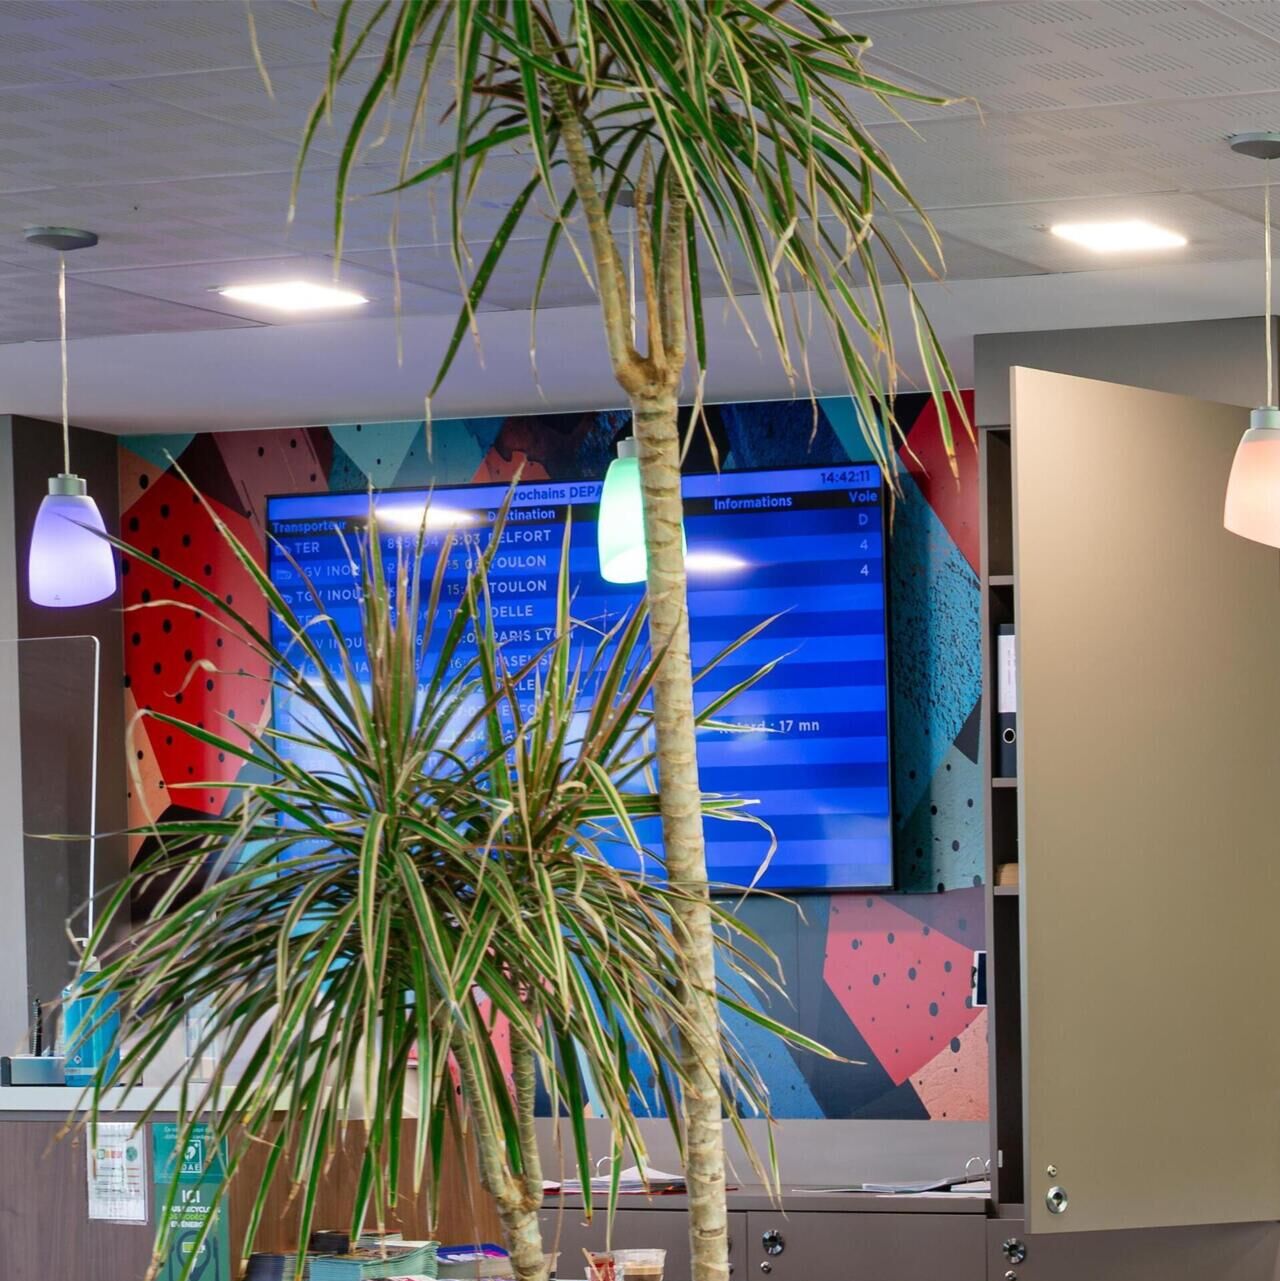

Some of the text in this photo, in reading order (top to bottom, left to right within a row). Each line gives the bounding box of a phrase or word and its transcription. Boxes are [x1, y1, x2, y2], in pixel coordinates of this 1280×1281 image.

[821, 470, 871, 484] 14:42:11
[506, 488, 566, 501] rochains
[849, 490, 878, 503] Voie
[714, 495, 793, 511] Informations
[859, 514, 868, 525] D
[295, 542, 320, 553] TER
[861, 539, 868, 550] 4
[860, 564, 869, 576] 4
[779, 720, 793, 732] 17
[799, 720, 820, 732] mn
